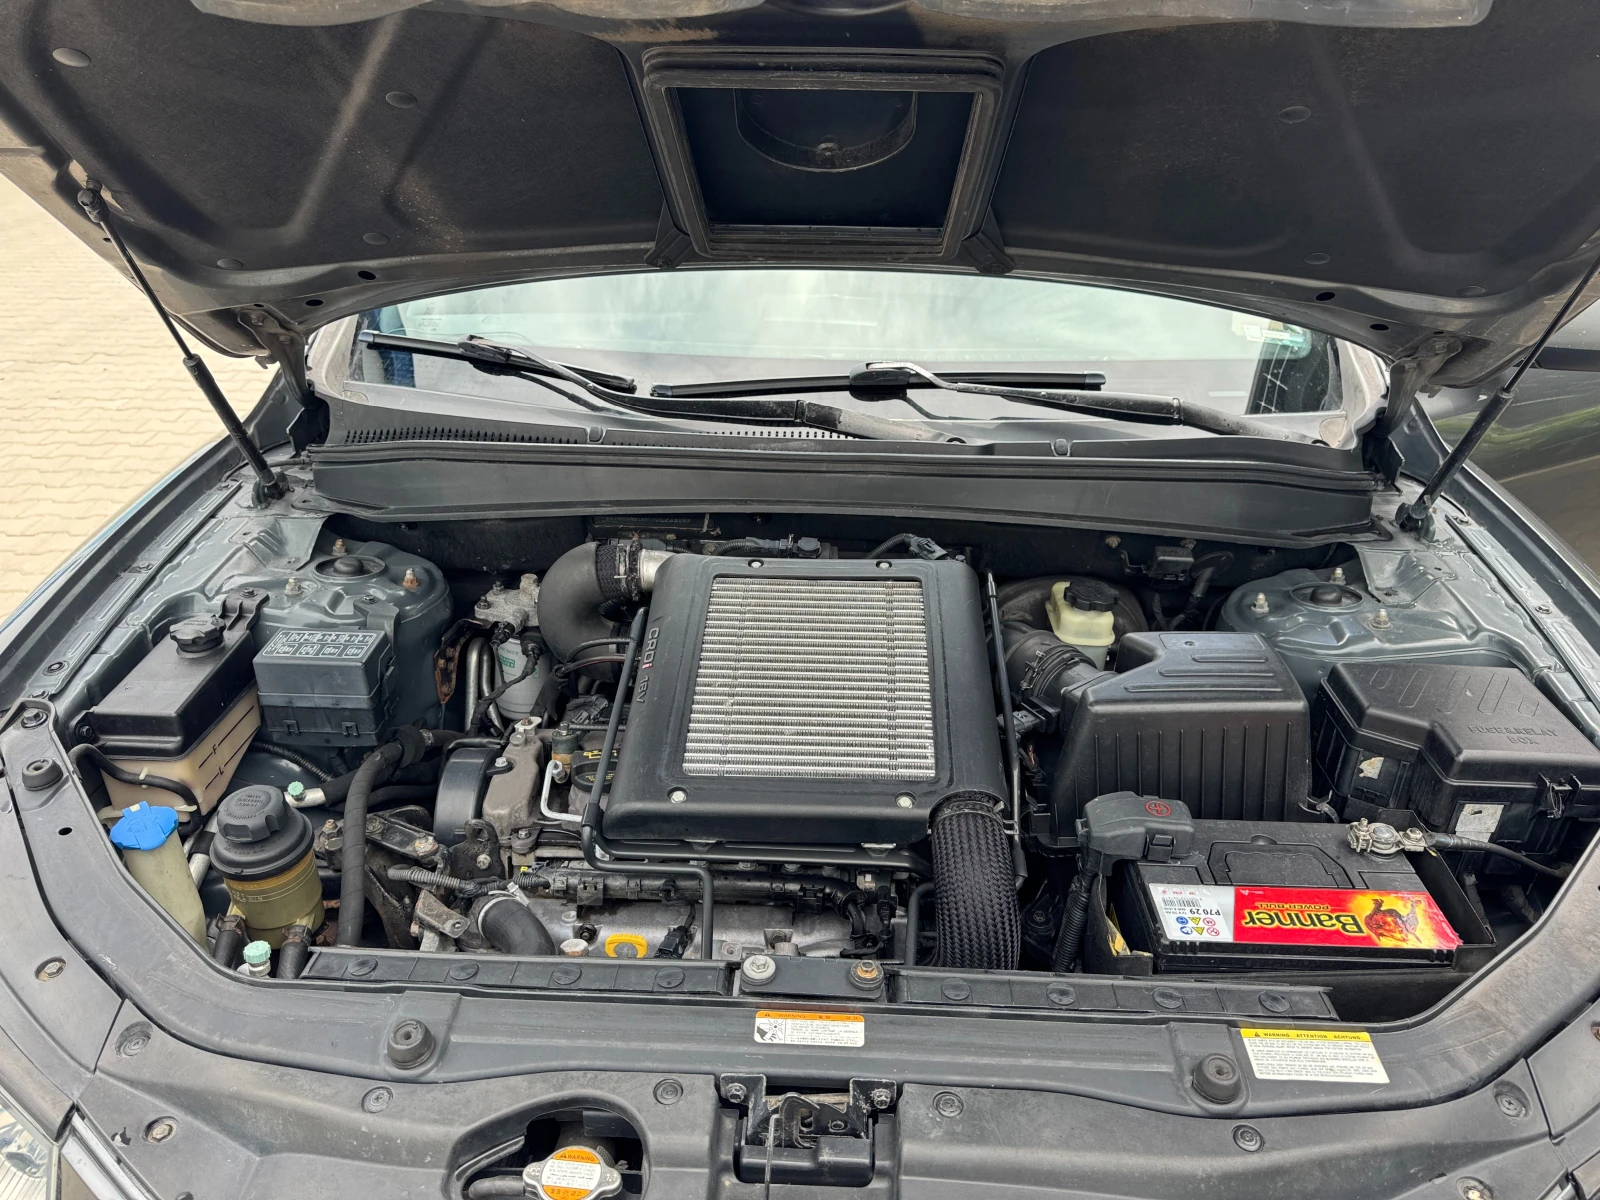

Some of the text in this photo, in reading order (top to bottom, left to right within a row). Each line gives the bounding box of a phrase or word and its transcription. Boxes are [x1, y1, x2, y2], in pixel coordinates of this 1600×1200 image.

[636, 627, 659, 703] CRDi 16V
[1203, 908, 1221, 916] P70
[1244, 911, 1366, 934] Banner
[567, 1154, 595, 1162] WARNING
